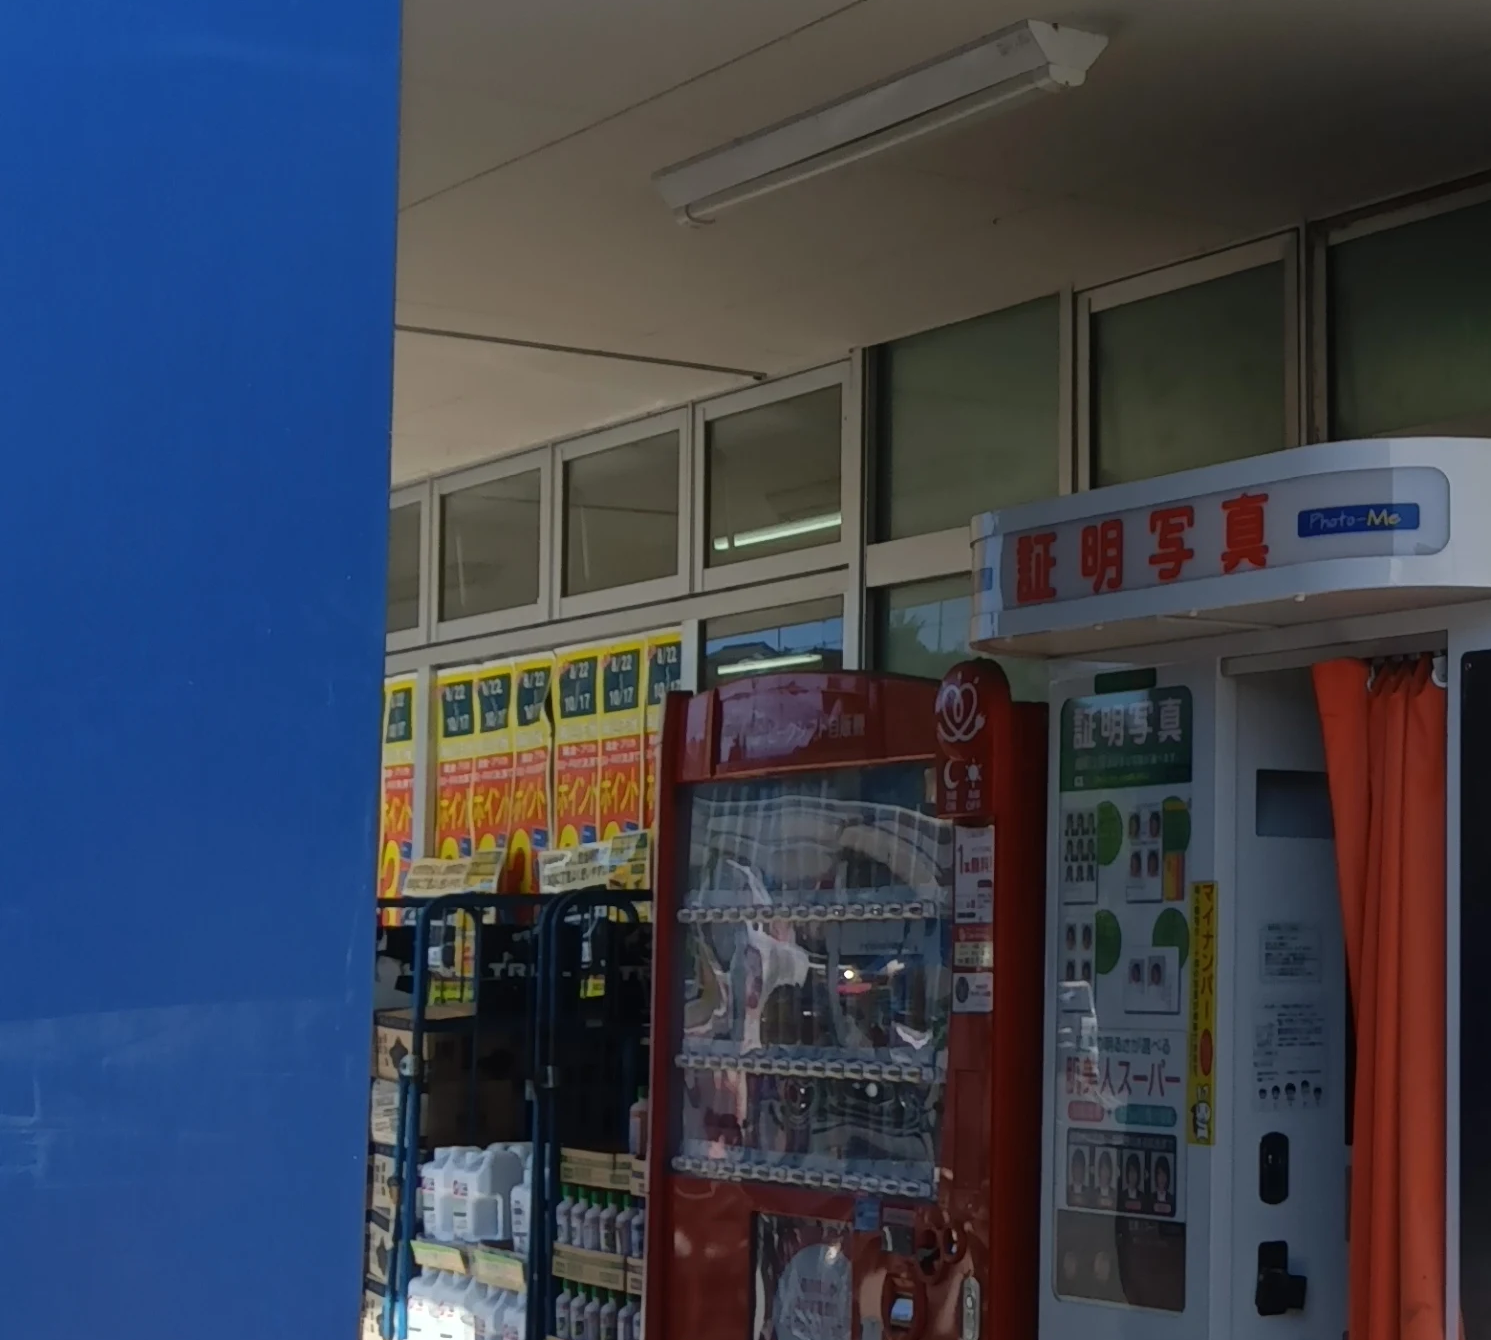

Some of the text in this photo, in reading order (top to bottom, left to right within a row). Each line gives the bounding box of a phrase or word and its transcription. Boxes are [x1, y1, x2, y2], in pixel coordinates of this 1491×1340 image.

[1016, 493, 1269, 604] 証明写真
[1309, 507, 1401, 532] Photo-Me
[1072, 697, 1183, 750] 証明写真
[1202, 883, 1214, 1018] マイナンバー
